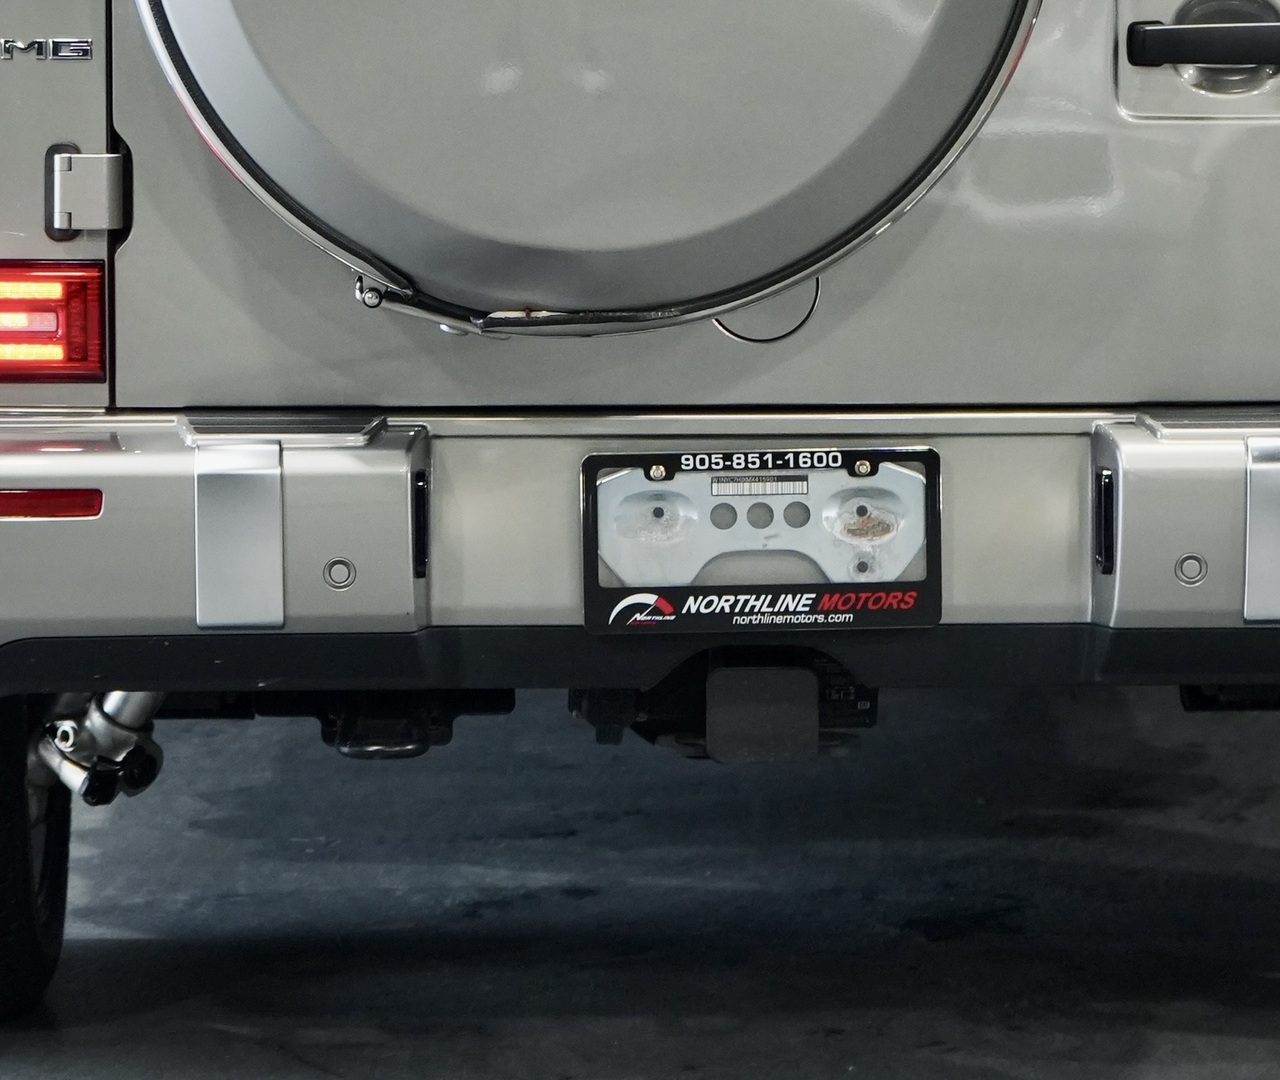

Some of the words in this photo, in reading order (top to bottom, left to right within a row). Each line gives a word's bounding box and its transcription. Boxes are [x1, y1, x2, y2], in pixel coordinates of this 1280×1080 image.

[681, 452, 842, 470] 905-851-1600
[681, 593, 817, 614] NORTHLINE
[817, 591, 918, 611] MOTORS
[732, 613, 854, 625] northlinemotors.com
